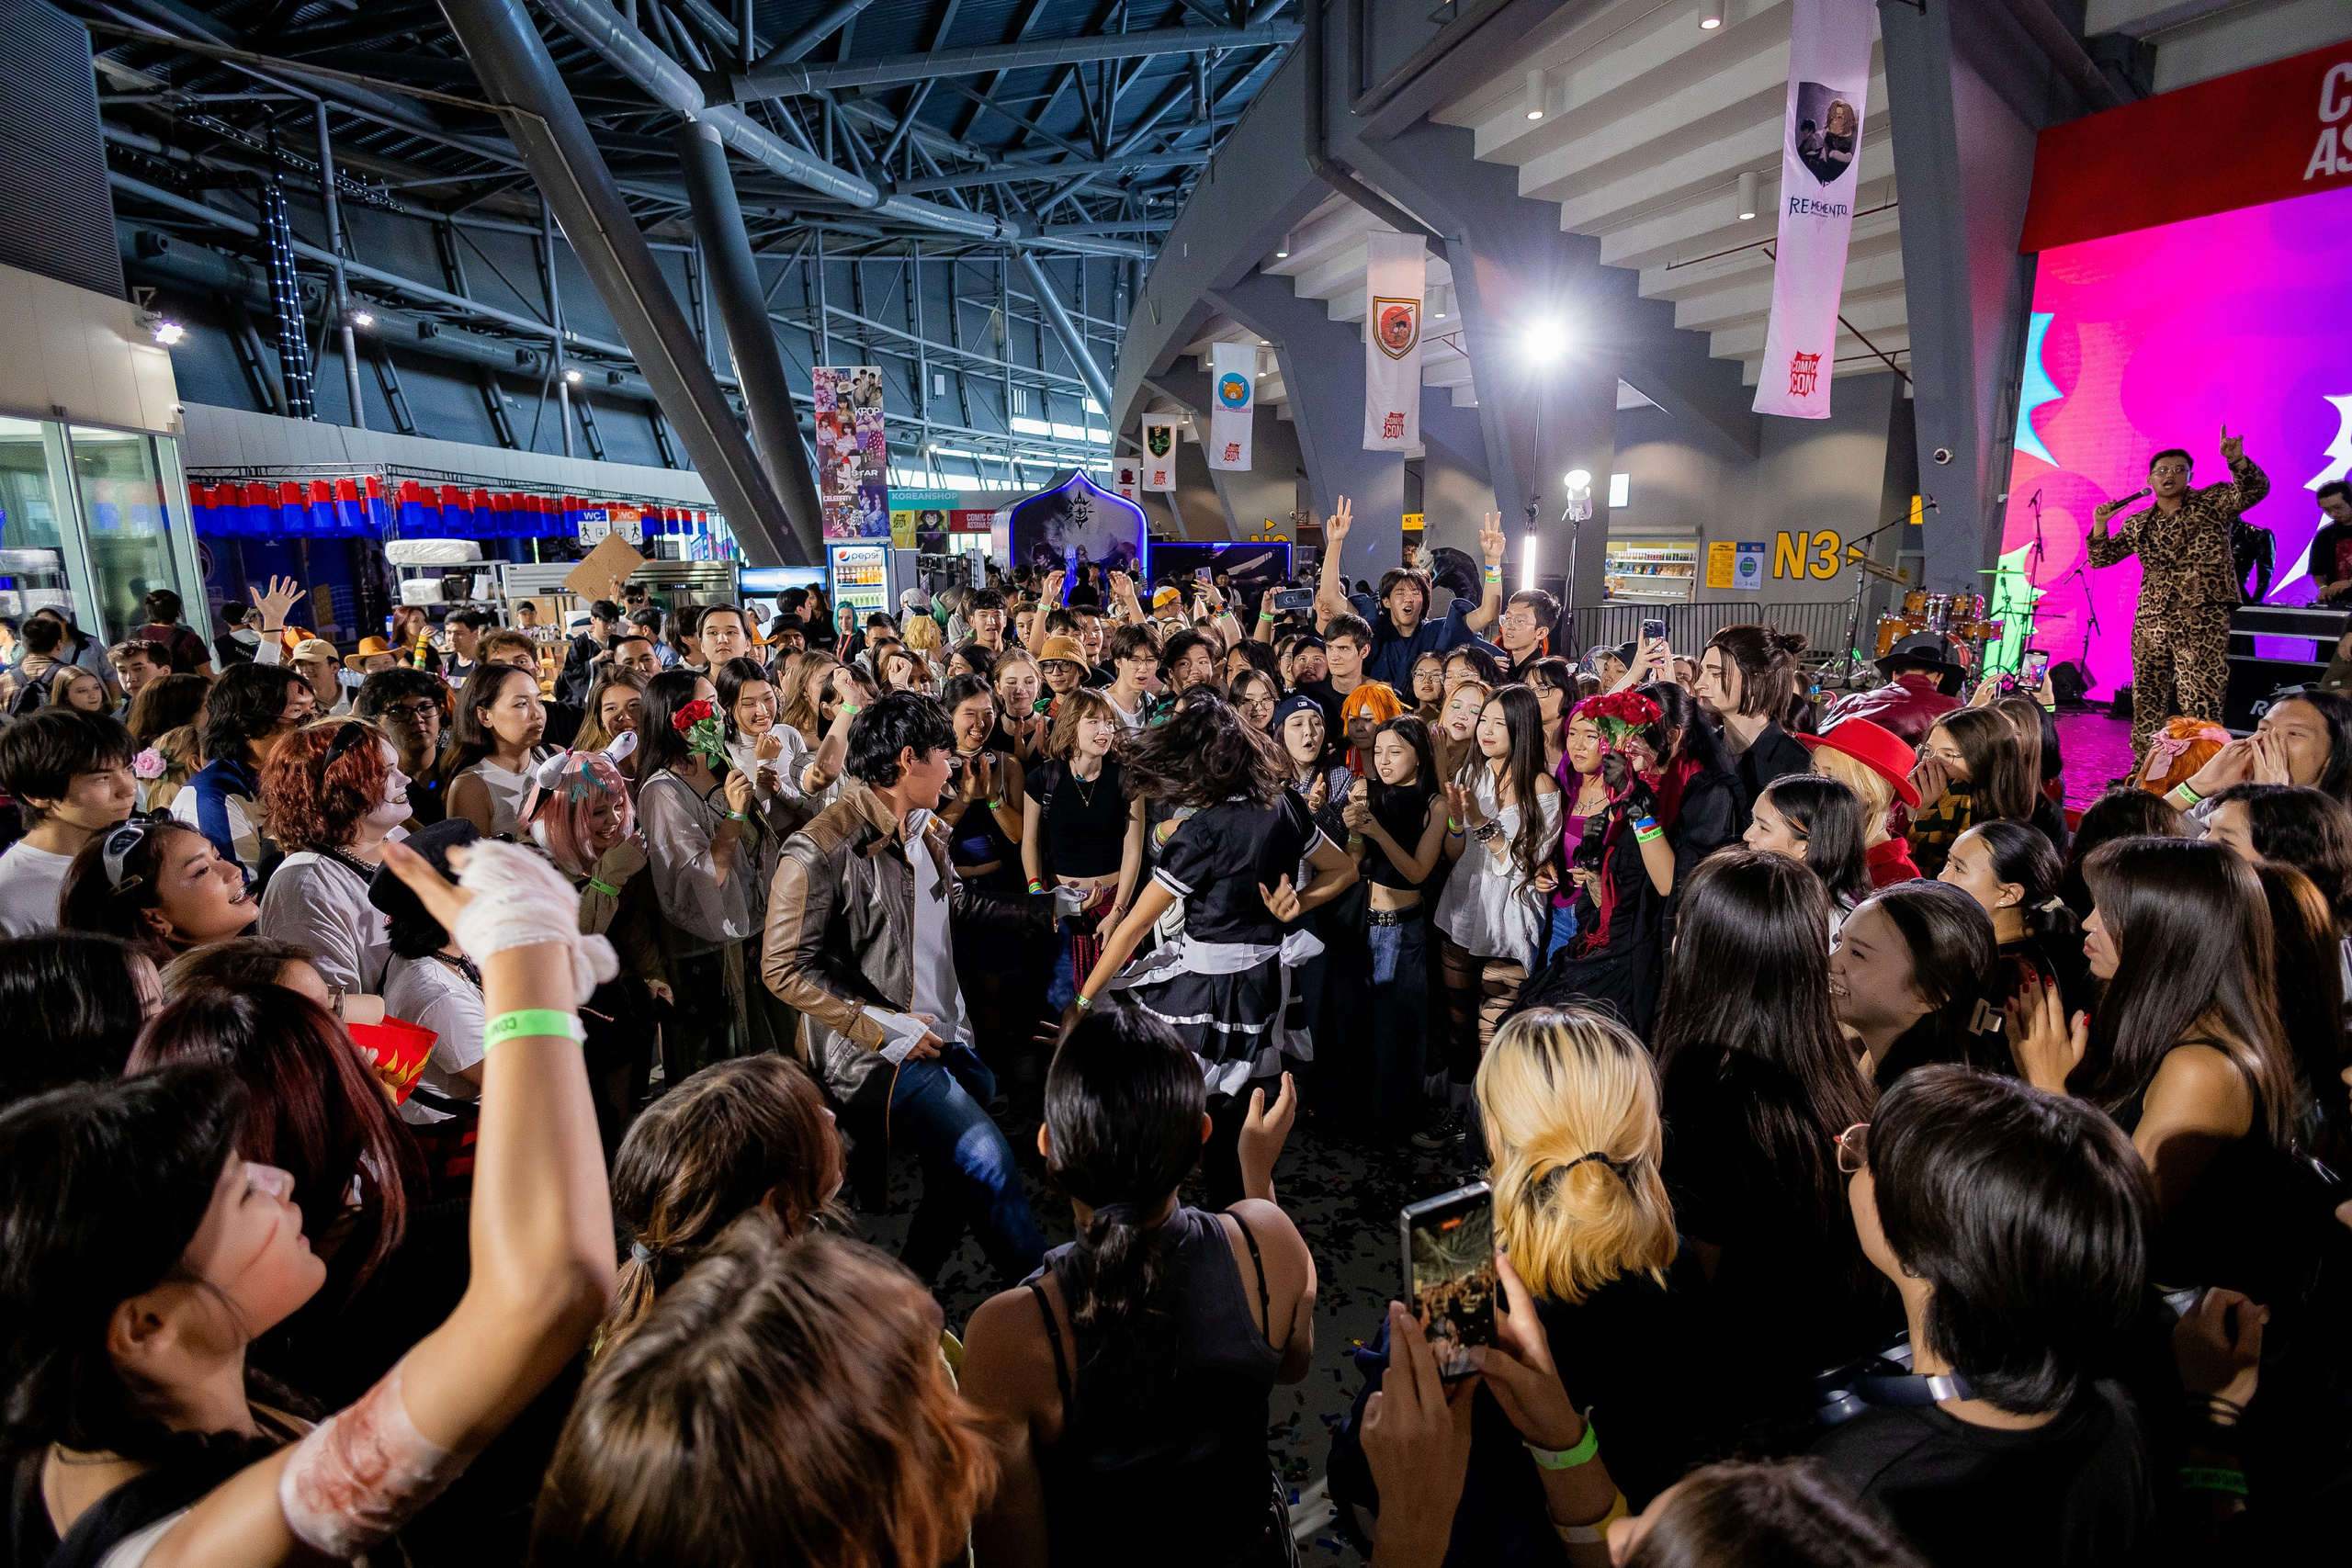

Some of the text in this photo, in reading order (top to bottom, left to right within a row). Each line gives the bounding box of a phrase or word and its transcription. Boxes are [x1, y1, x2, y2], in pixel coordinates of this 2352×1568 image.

[1792, 360, 1816, 373] COMIC
[1792, 373, 1814, 392] CON
[854, 407, 880, 416] KPOP
[1385, 424, 1402, 436] CON
[892, 492, 958, 501] KOREANSHOP
[583, 512, 601, 521] WC
[617, 511, 635, 520] WC
[967, 513, 986, 522] COMIC
[967, 521, 986, 529] ASTANA
[851, 551, 878, 561] pepsi
[1772, 529, 1841, 581] N3
